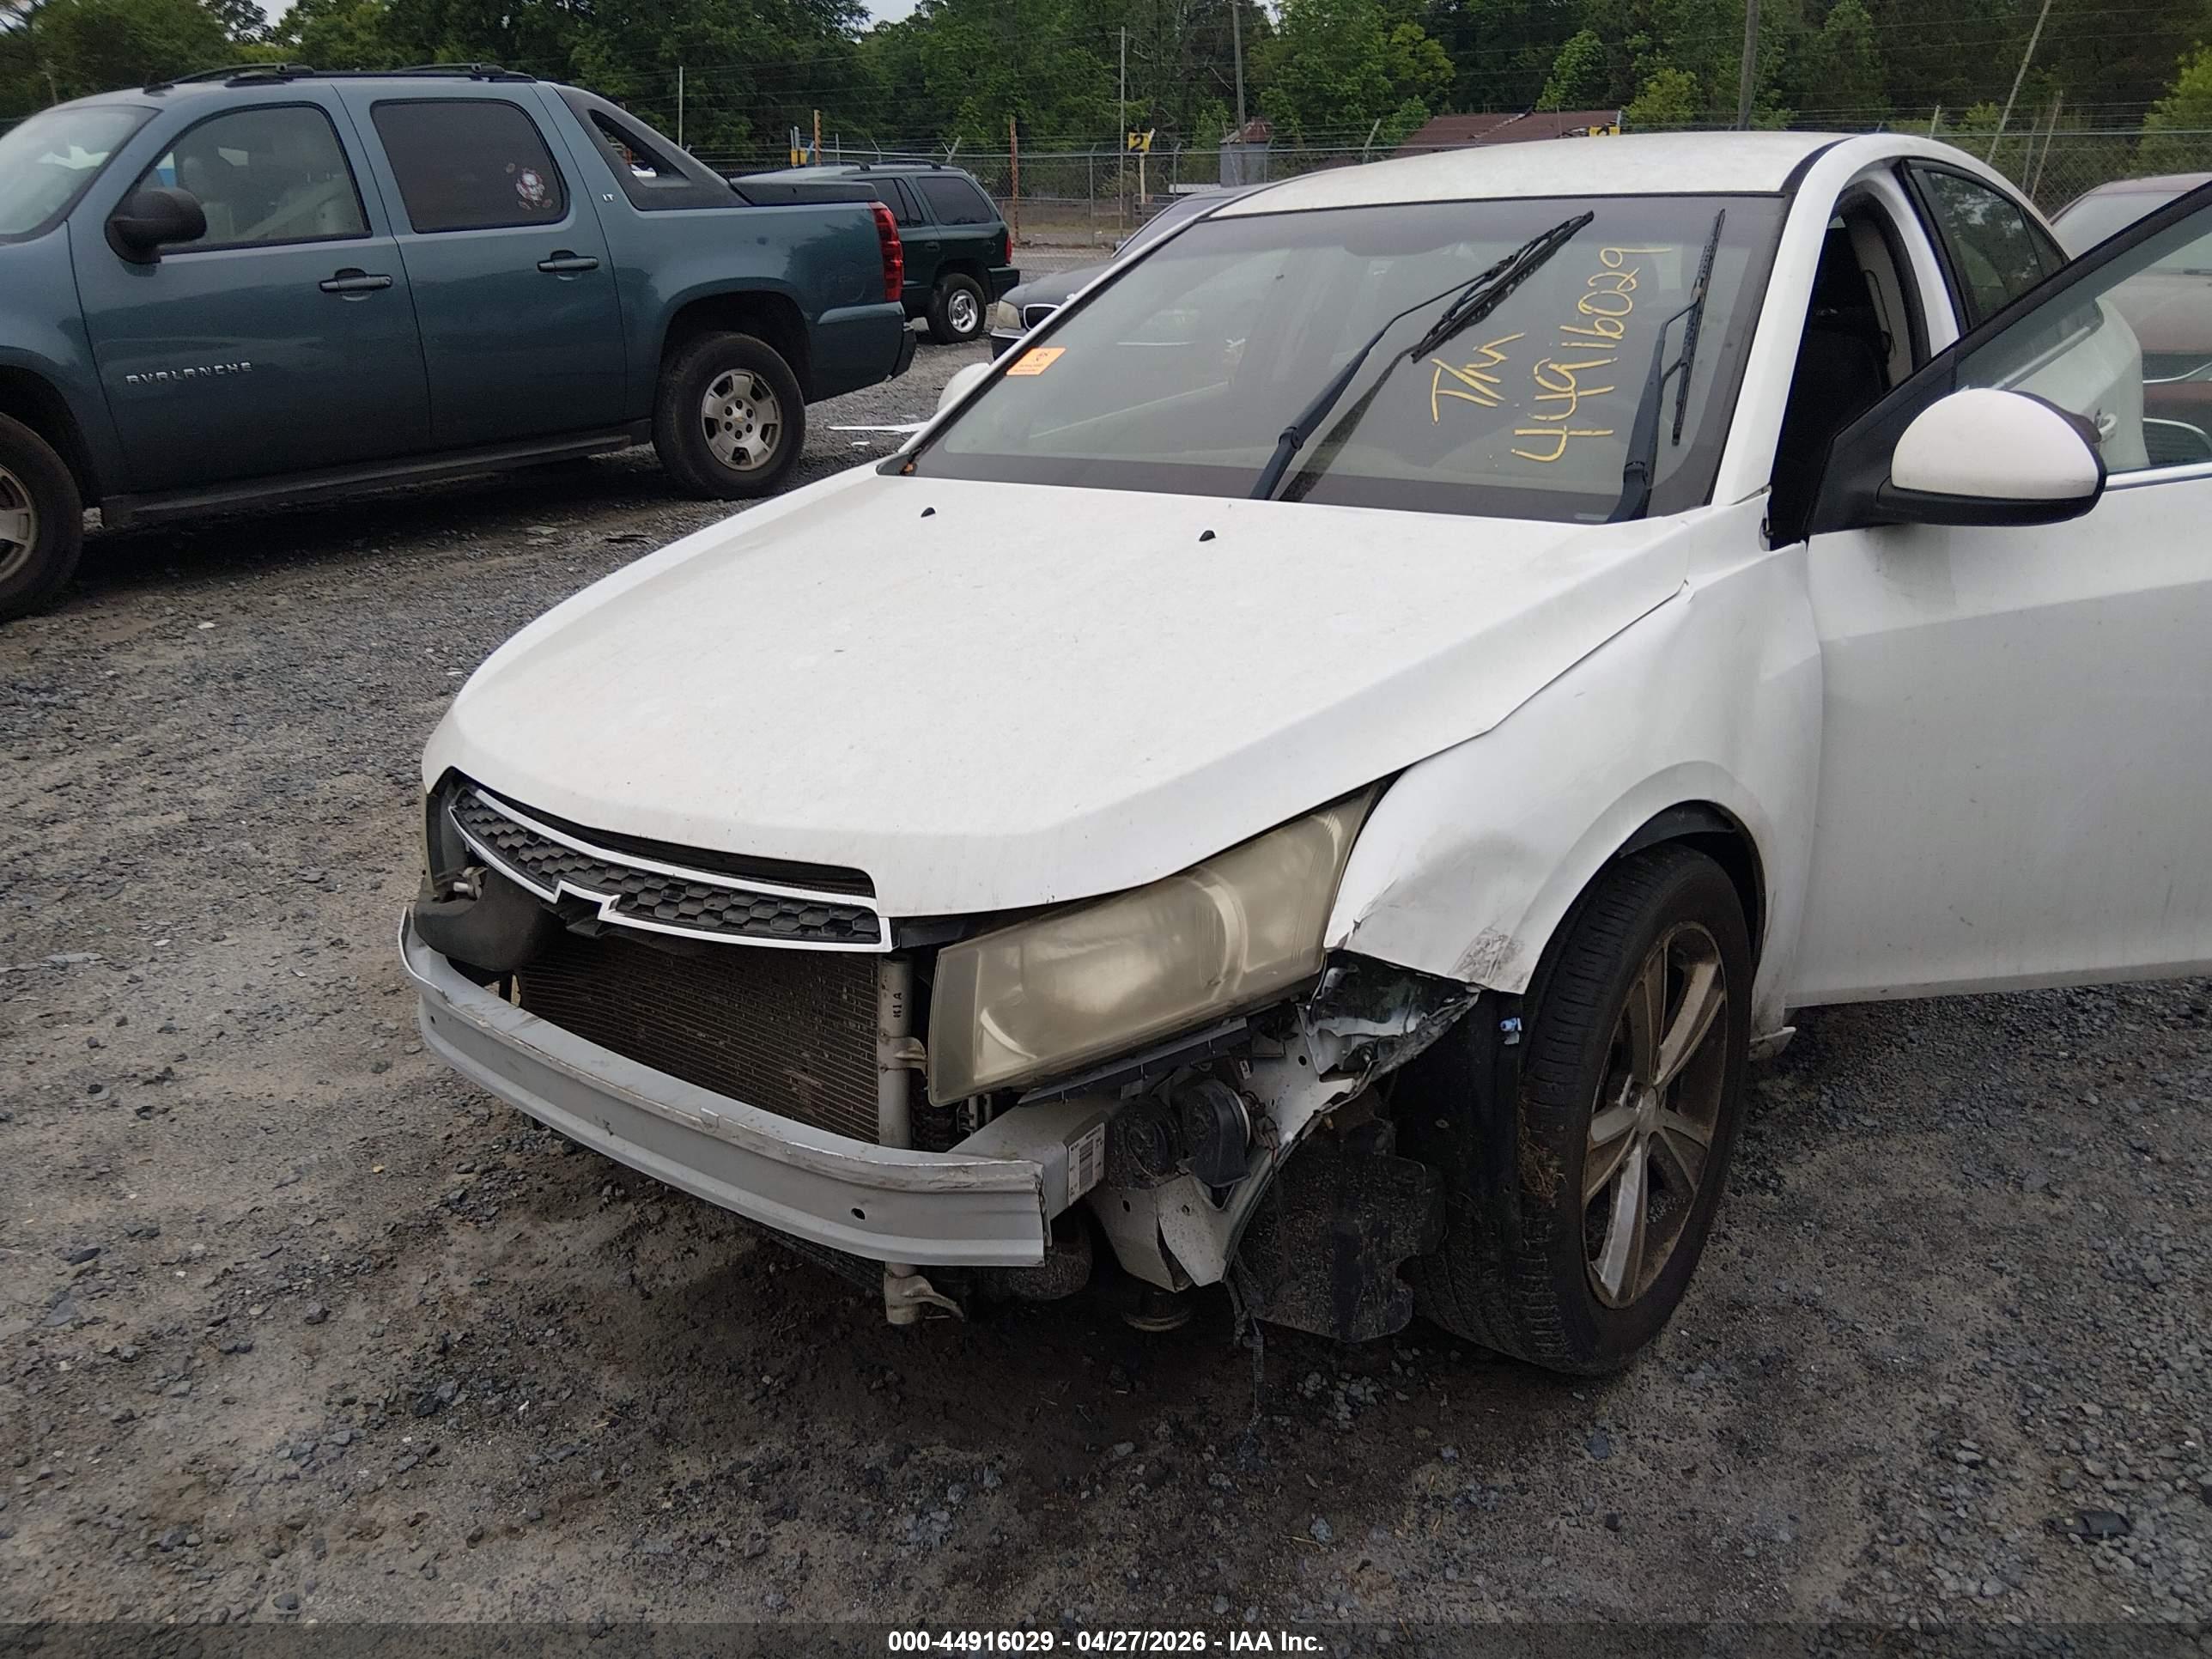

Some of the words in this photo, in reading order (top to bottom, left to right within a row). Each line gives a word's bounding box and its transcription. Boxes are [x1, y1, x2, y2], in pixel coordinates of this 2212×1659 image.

[1129, 134, 1145, 152] 2
[1510, 246, 1672, 463] 44916029
[125, 361, 253, 386] AVALANCHE
